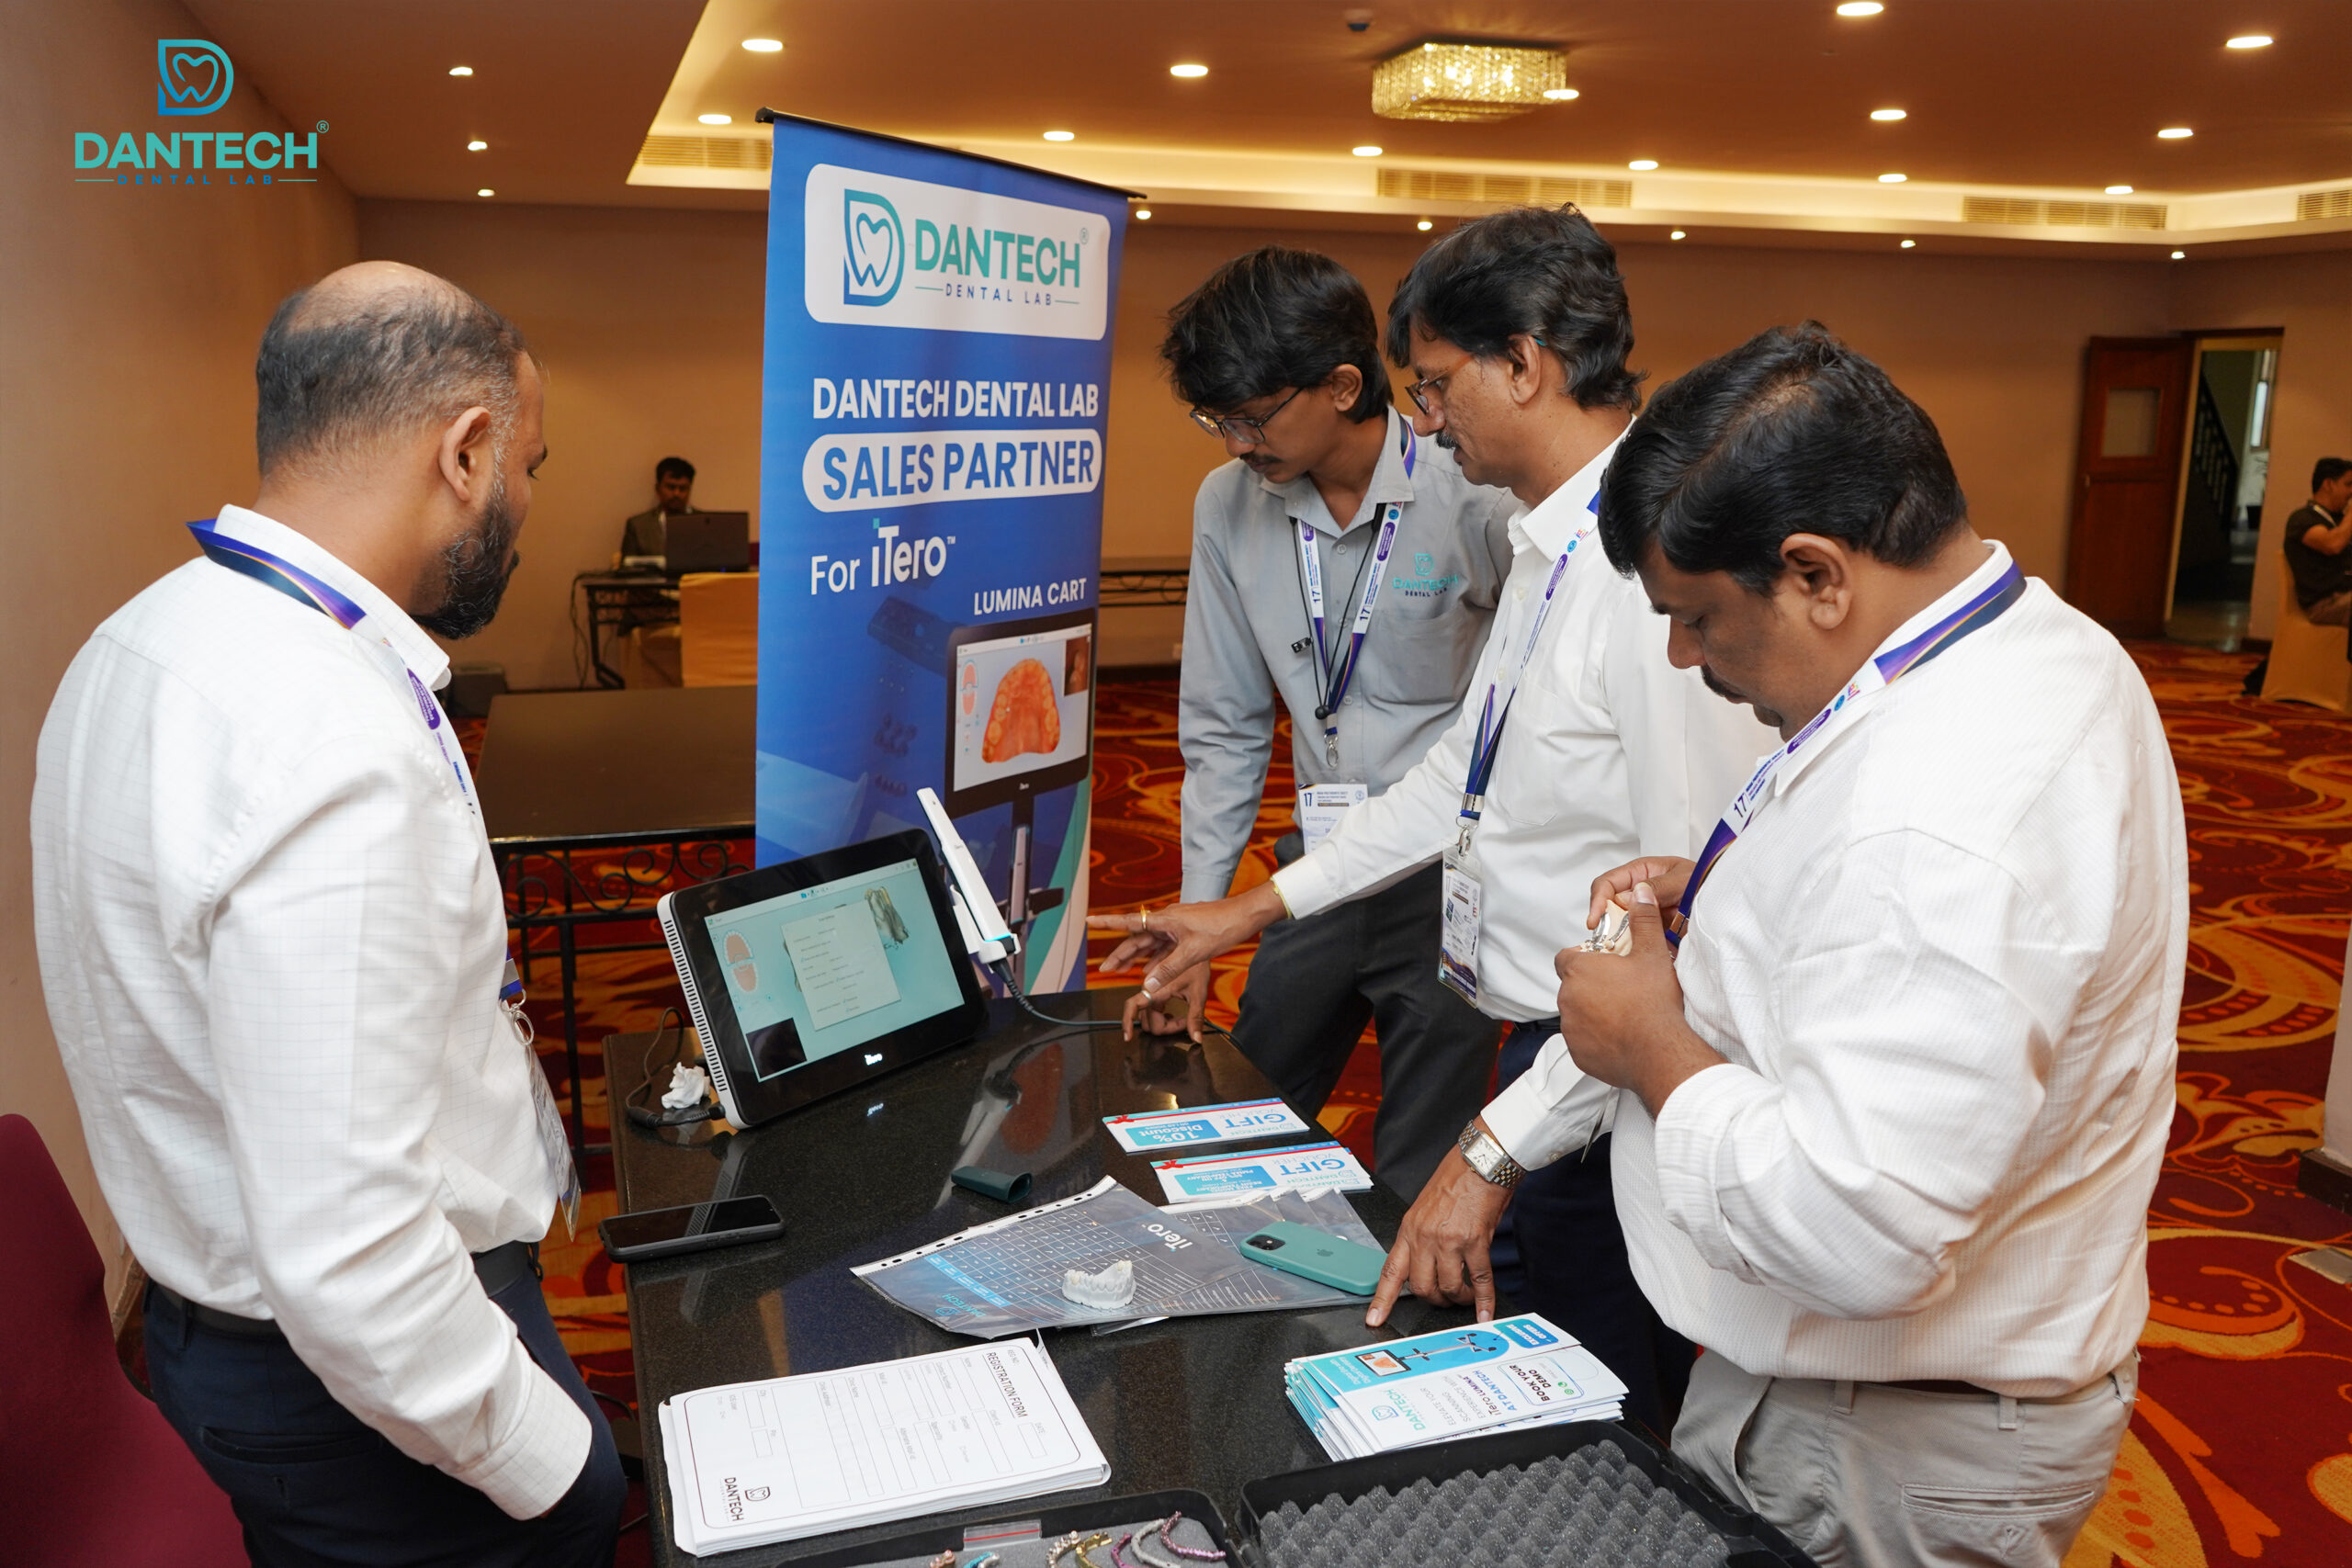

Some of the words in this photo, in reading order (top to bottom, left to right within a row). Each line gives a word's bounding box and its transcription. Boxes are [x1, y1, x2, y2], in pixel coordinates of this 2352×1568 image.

[945, 283, 1012, 302] DENTAL
[1024, 288, 1052, 306] LAB
[813, 378, 950, 419] DANTECH
[955, 380, 1055, 417] DENTAL
[1060, 384, 1099, 417] LAB
[823, 444, 934, 501] SALES
[943, 440, 1094, 491] PARTNER
[810, 556, 861, 595] For
[1392, 574, 1458, 591] DANTECH
[974, 586, 1043, 615] LUMINA
[1047, 578, 1087, 606] CART
[1138, 1123, 1204, 1136] Discount
[1225, 1113, 1287, 1129] GIFT
[1153, 1132, 1199, 1143] 10%
[1280, 1159, 1346, 1177] GIFT
[1510, 1364, 1530, 1381] YOUR
[1529, 1370, 1552, 1388] DEMO
[985, 1351, 1018, 1397] REGISTRATION
[1008, 1396, 1029, 1417] FORM
[1473, 1370, 1508, 1400] DANTECH
[1526, 1382, 1551, 1402] BOOK
[1386, 1388, 1427, 1430] DANTECH
[1482, 1396, 1502, 1416] iTero
[1501, 1402, 1518, 1411] AT
[722, 1476, 746, 1521] DANTECH
